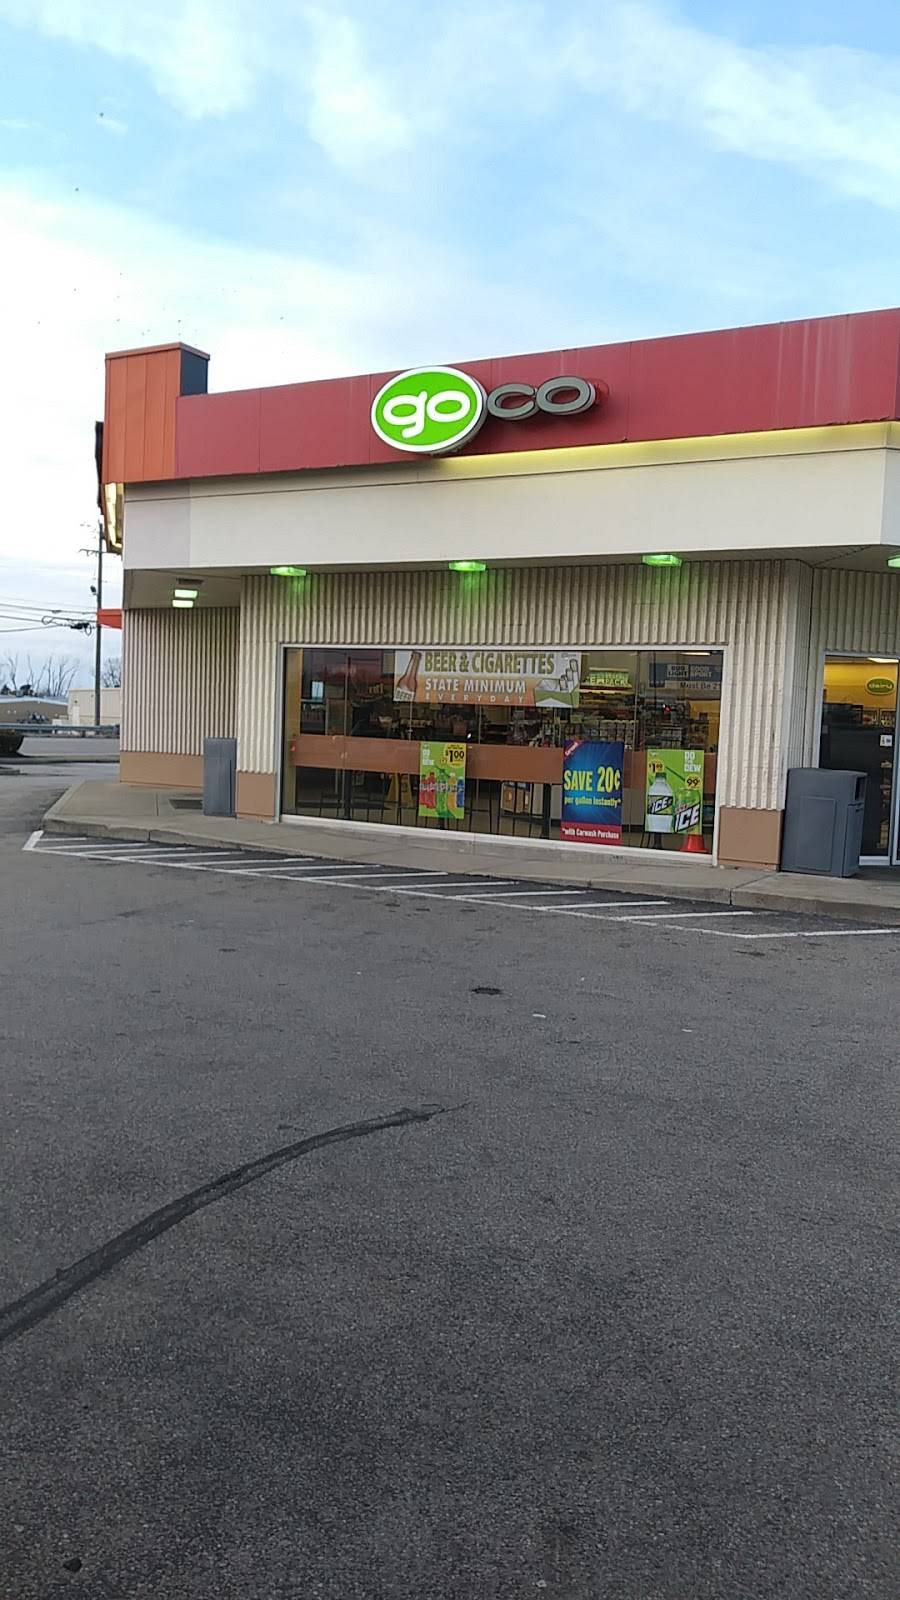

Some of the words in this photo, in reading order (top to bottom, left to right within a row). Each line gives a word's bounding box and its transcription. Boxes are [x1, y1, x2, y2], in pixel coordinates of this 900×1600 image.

[383, 391, 470, 438] go
[425, 652, 456, 672] BEER
[459, 653, 469, 672] &
[472, 653, 555, 674] CIGARETTES
[425, 678, 458, 691] STATE
[464, 679, 526, 693] MINIMUM
[425, 693, 523, 703] EVERYDAY
[564, 770, 593, 791] SAVE
[597, 766, 621, 793] 20¢
[651, 797, 668, 814] ICE
[675, 804, 700, 832] ICE
[597, 830, 620, 839] Purchase
